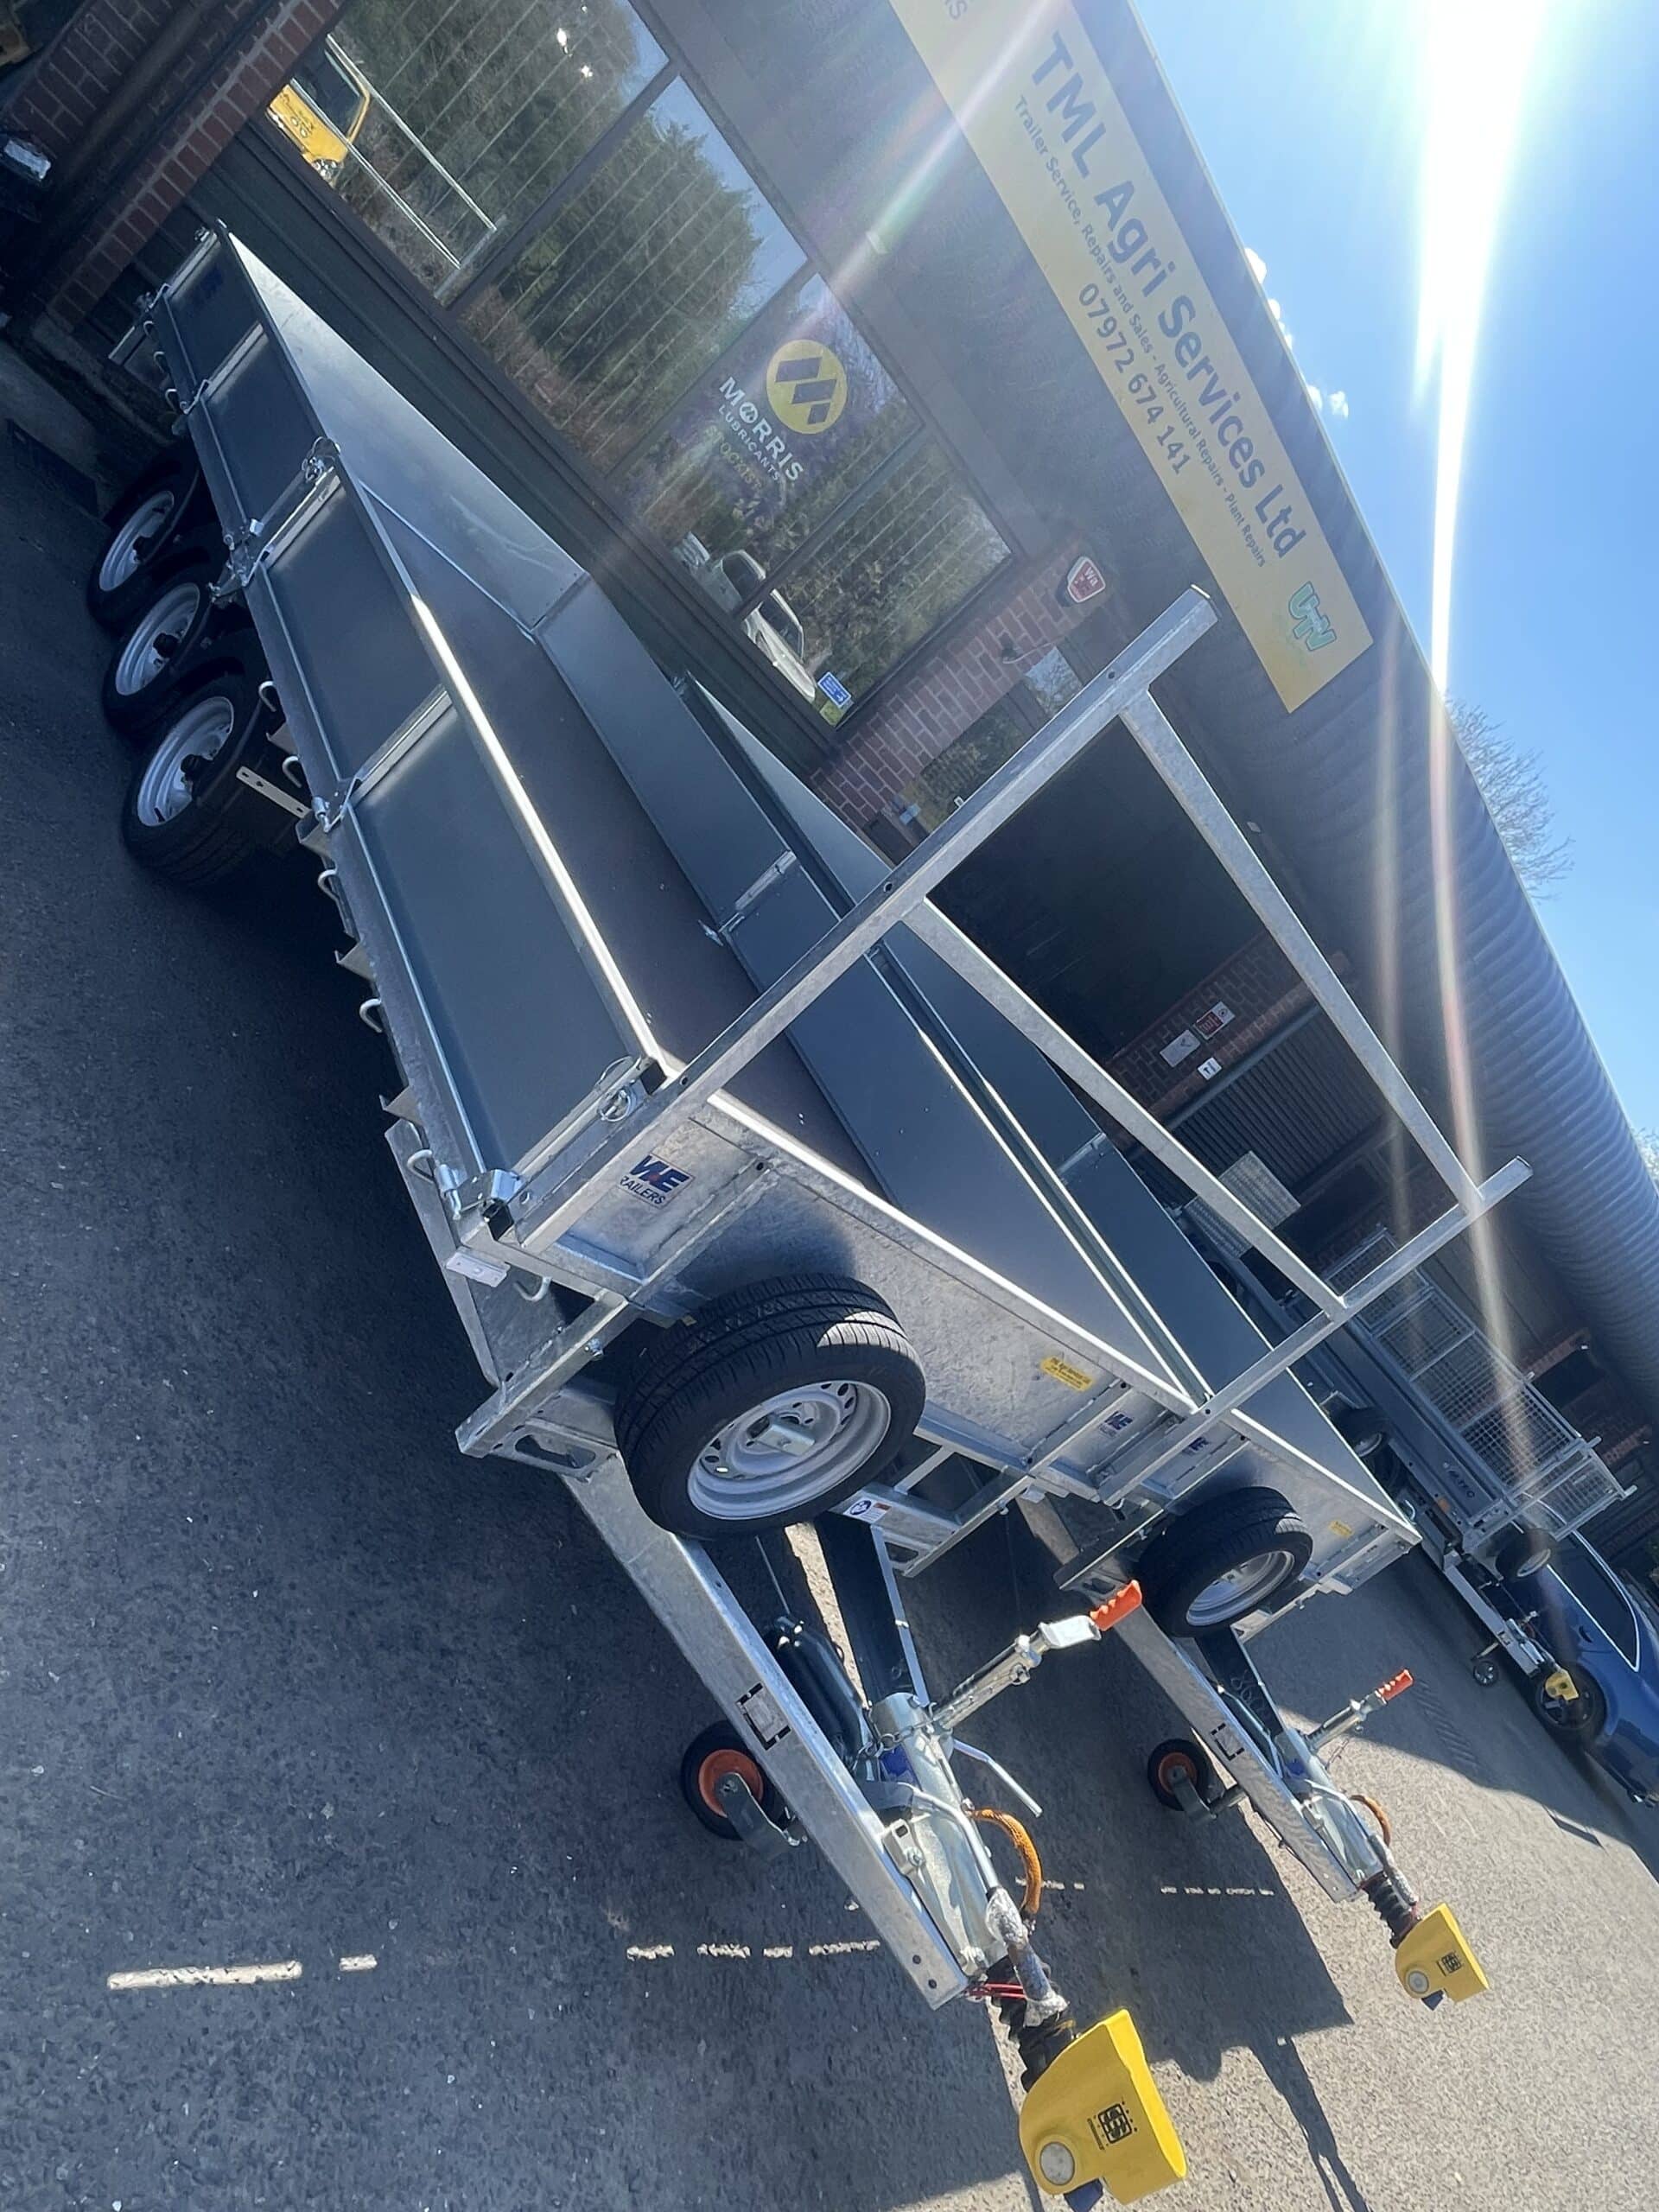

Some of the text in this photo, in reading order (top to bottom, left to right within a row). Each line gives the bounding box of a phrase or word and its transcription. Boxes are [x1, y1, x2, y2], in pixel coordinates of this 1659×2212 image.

[1015, 94, 1049, 155] Trailer
[1046, 156, 1081, 225] Service,
[1081, 224, 1116, 284] Repairs
[1113, 284, 1135, 314] and
[1128, 313, 1154, 353] Sales
[1154, 363, 1201, 440] Agricultural
[1196, 438, 1224, 486] Repairs
[1224, 493, 1245, 526] Plant
[1242, 524, 1266, 568] Repairs
[1032, 30, 1307, 559] TML Agri Services Ltd
[718, 404, 781, 480] LUBRICANTS
[719, 377, 804, 481] MORRIS
[1078, 283, 1191, 475] 07972 674 141
[620, 1175, 666, 1205] RAILERS
